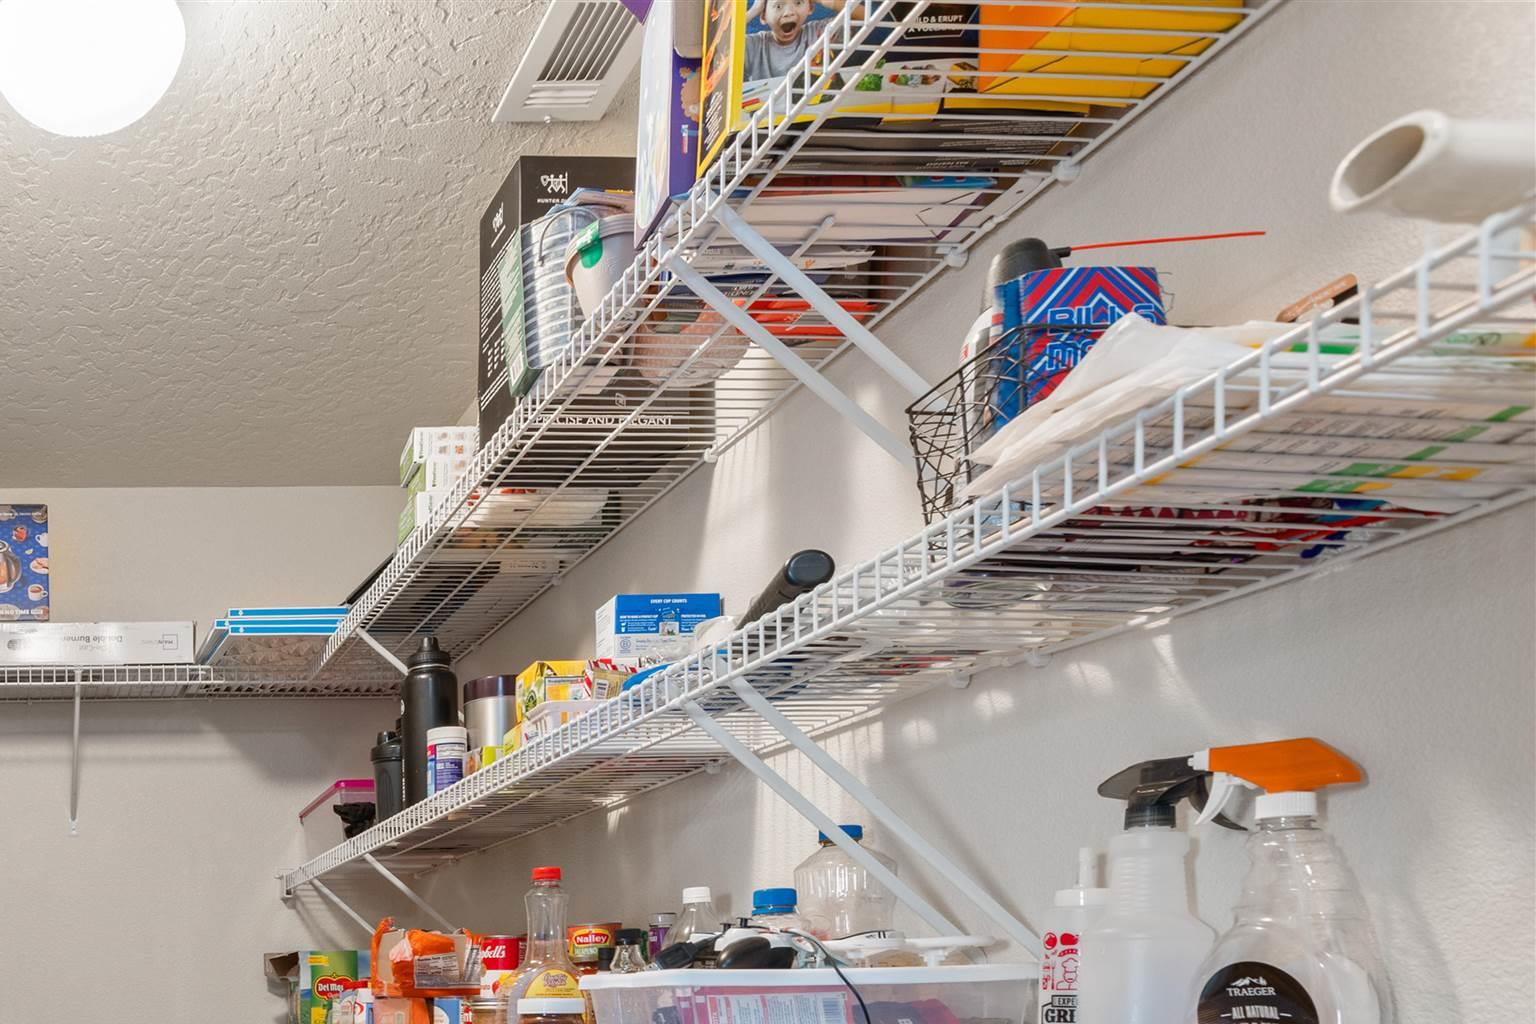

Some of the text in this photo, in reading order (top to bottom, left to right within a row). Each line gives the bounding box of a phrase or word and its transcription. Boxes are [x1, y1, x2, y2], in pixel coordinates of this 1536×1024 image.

[536, 416, 673, 425] PRECISE AND ELEGANT
[576, 933, 607, 944] Nalley
[317, 982, 330, 993] Del
[1226, 986, 1276, 997] TRAEGER
[1045, 1009, 1076, 1023] GRI
[1232, 1005, 1280, 1020] ALL NATURAL
